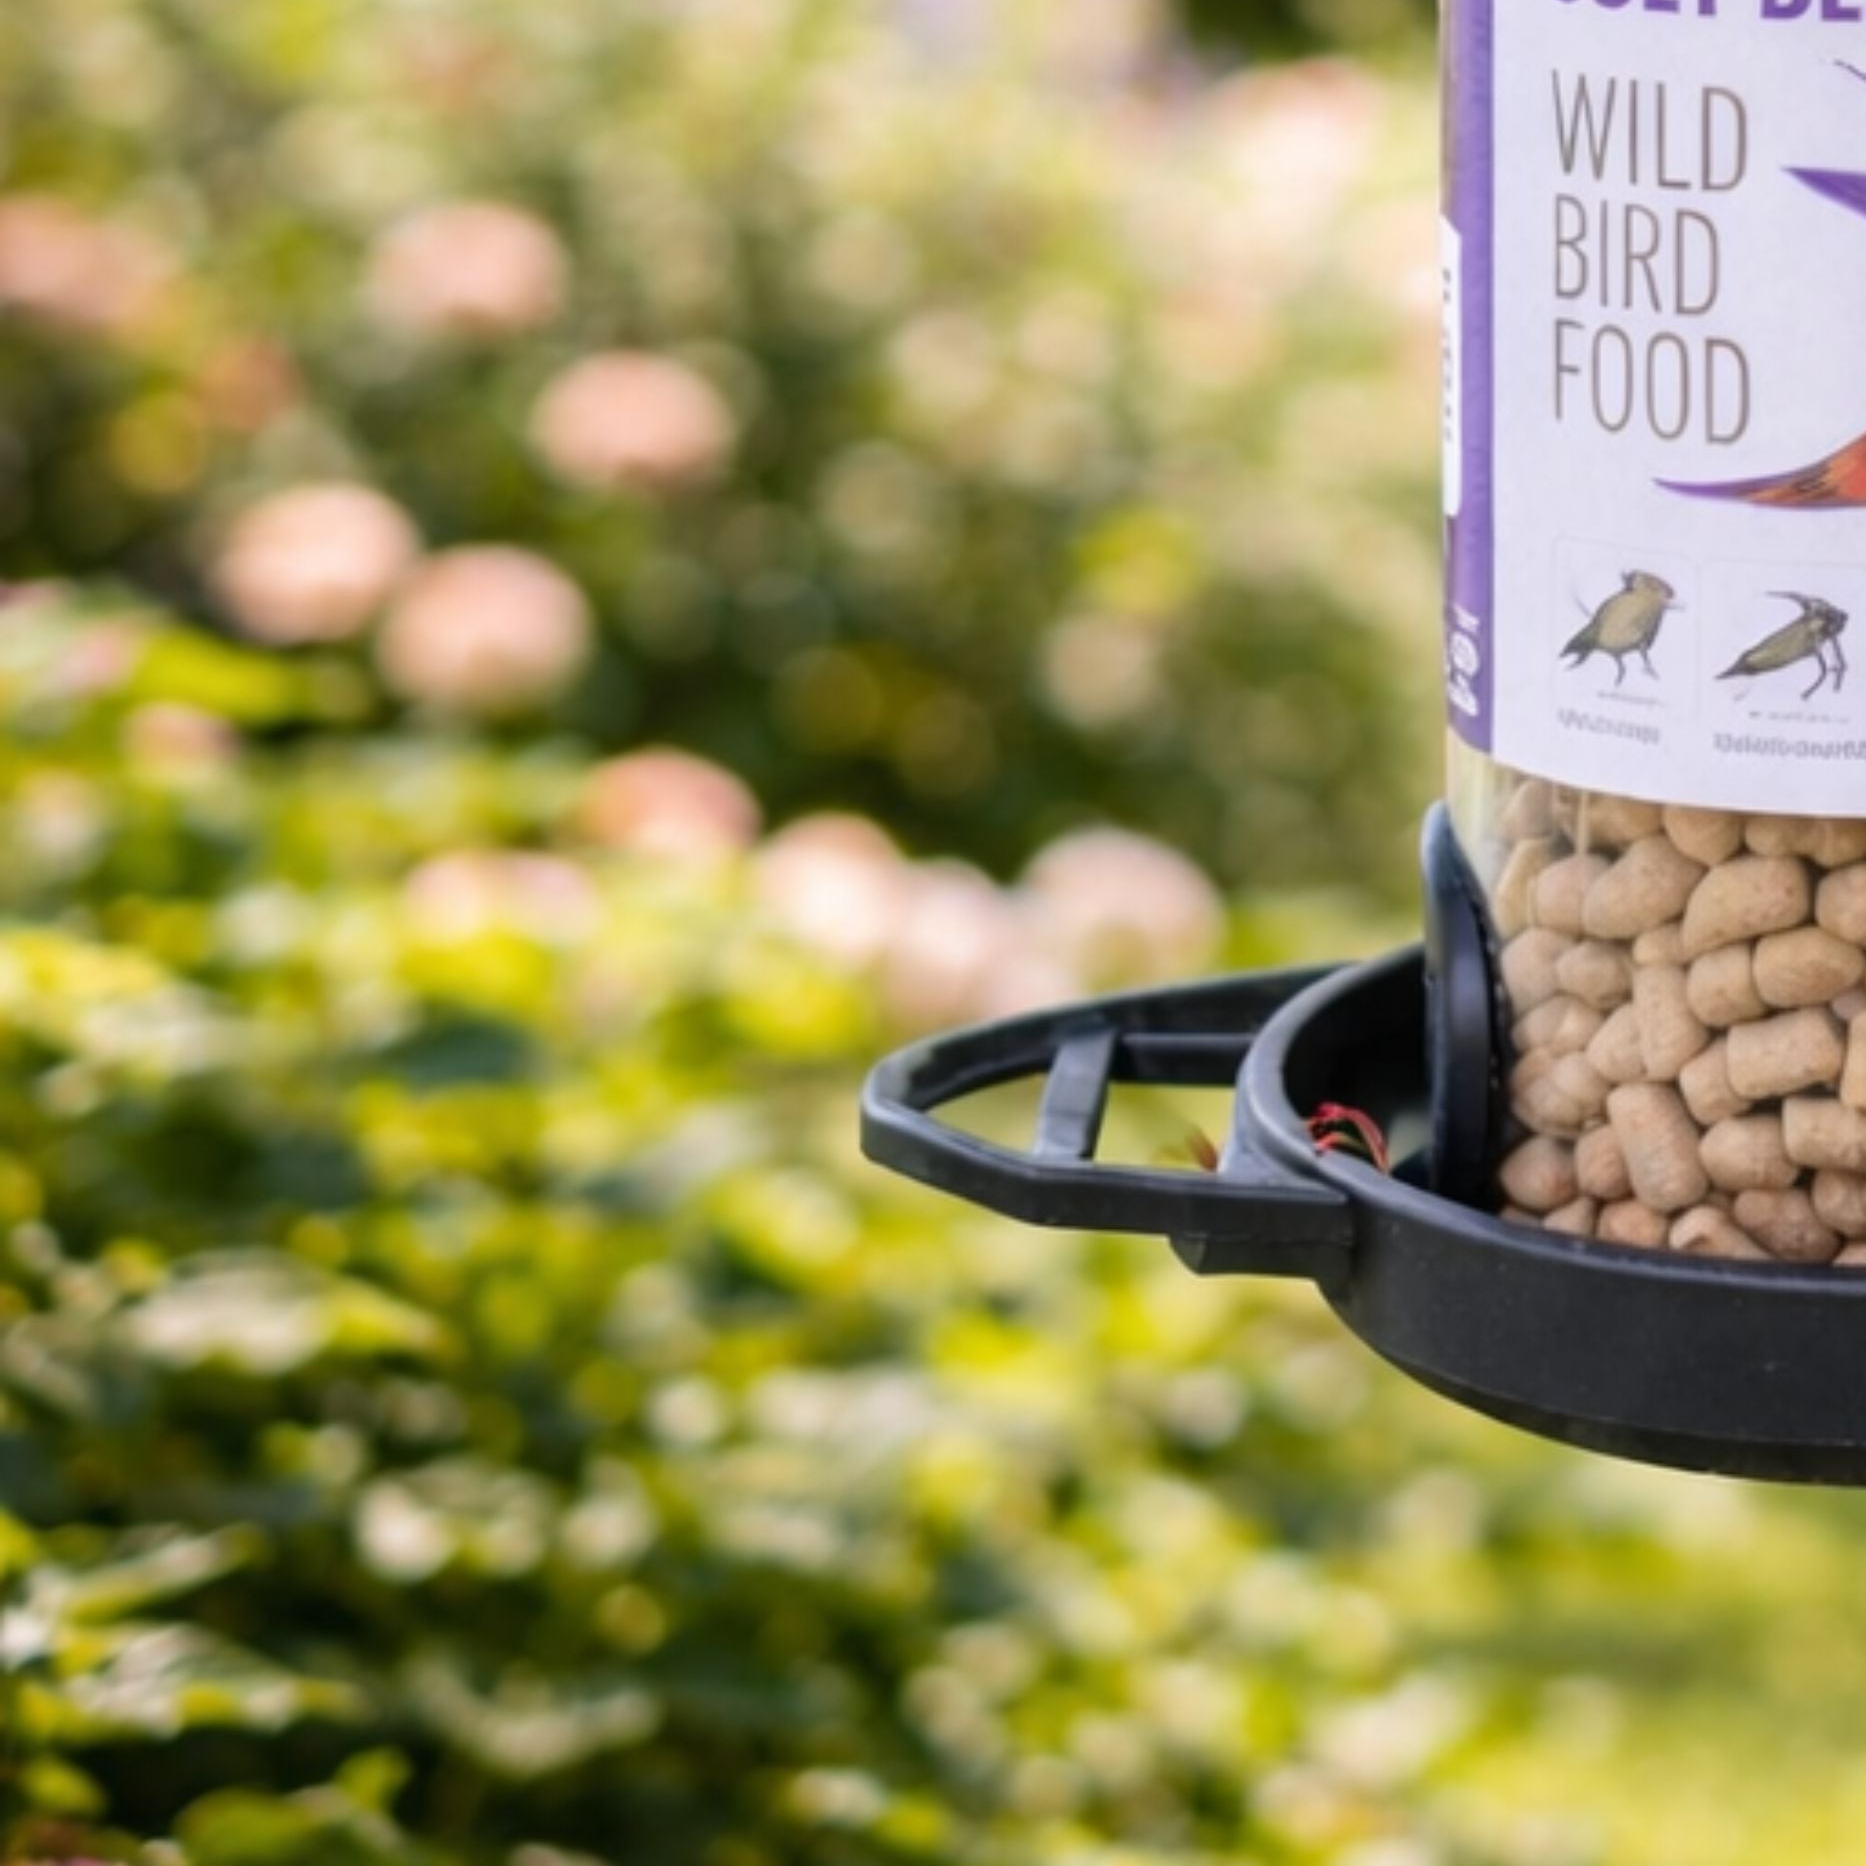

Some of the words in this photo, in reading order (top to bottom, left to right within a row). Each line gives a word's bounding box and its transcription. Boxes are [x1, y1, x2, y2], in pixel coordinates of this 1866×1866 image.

[1551, 67, 1748, 193] WILD
[1554, 192, 1721, 317] BIRD
[1554, 316, 1752, 446] FOOD
